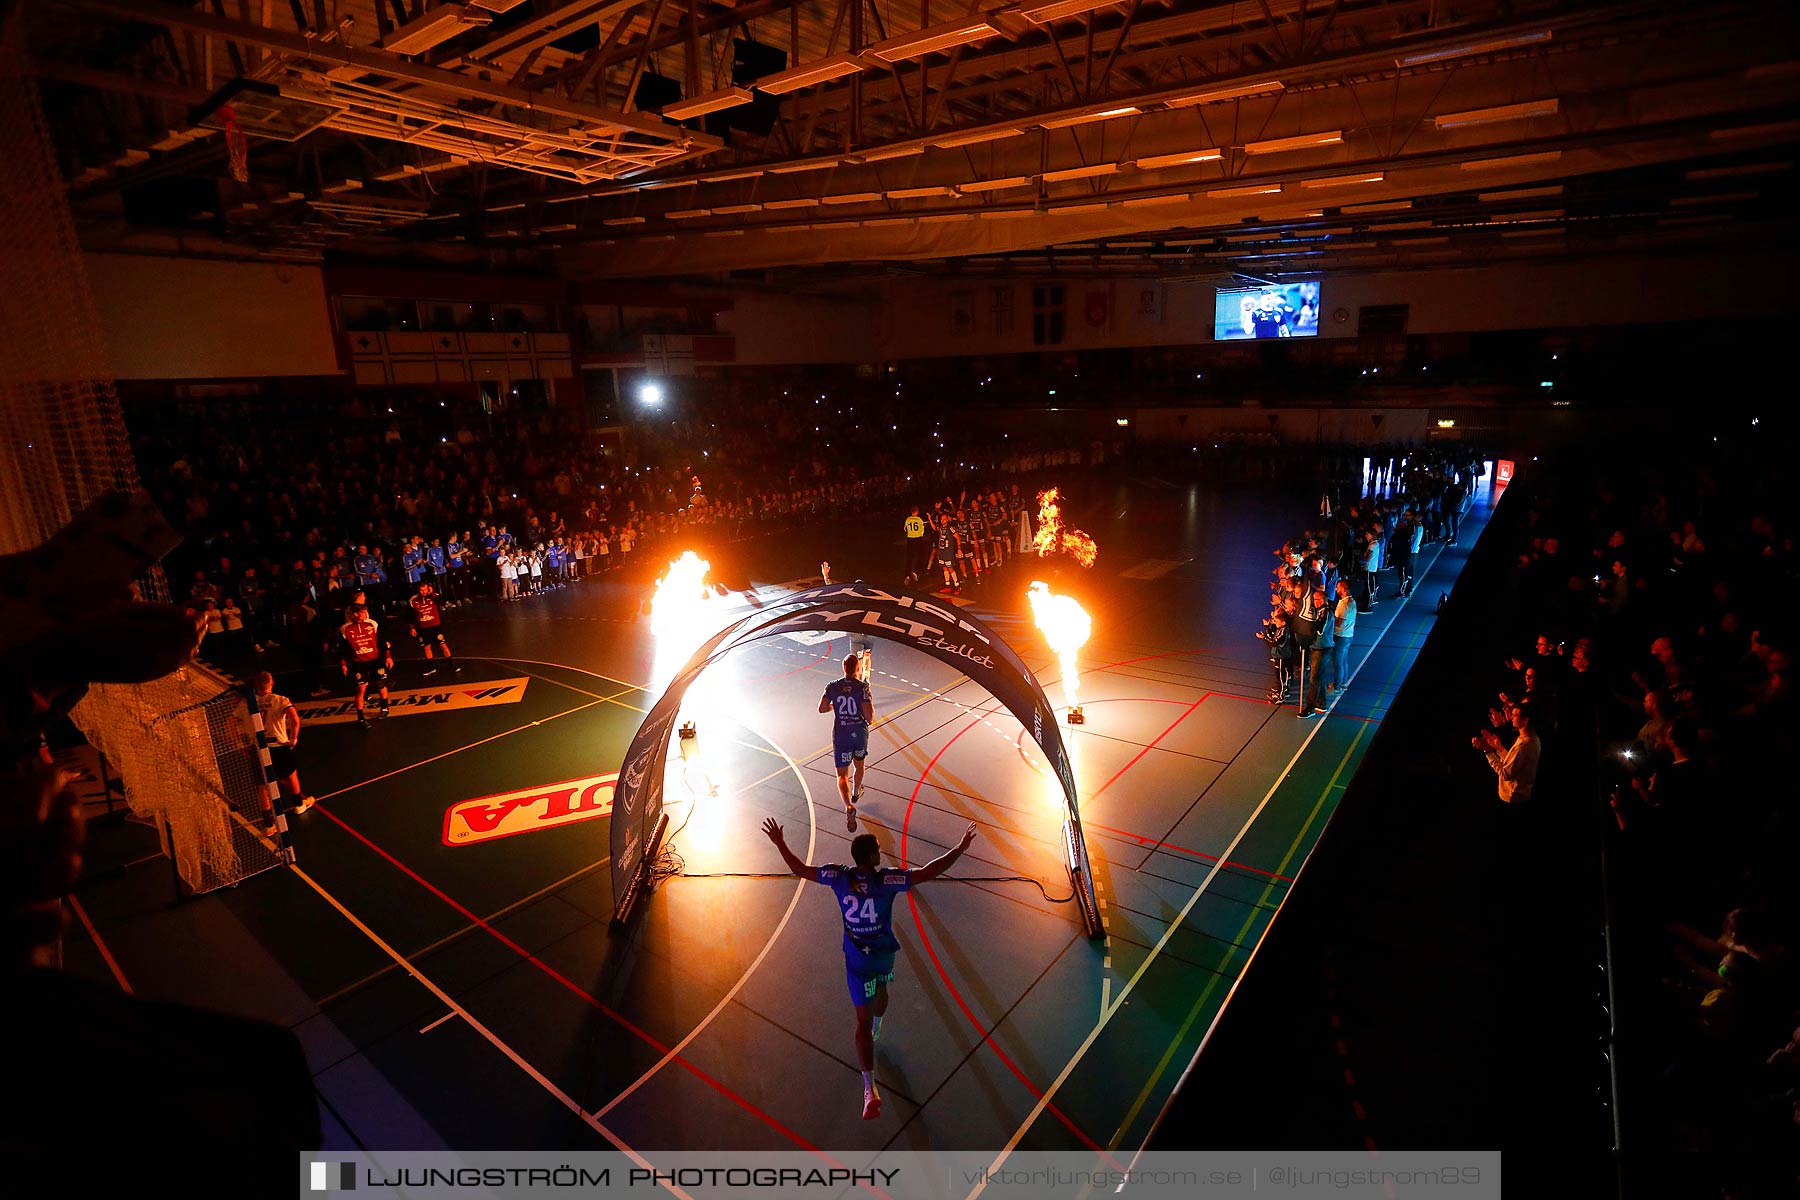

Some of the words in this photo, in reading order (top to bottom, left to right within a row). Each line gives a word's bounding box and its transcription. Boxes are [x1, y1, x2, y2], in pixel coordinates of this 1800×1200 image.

[908, 521, 919, 531] 16
[836, 695, 858, 716] 20
[455, 779, 617, 833] ULA
[842, 895, 878, 924] 24
